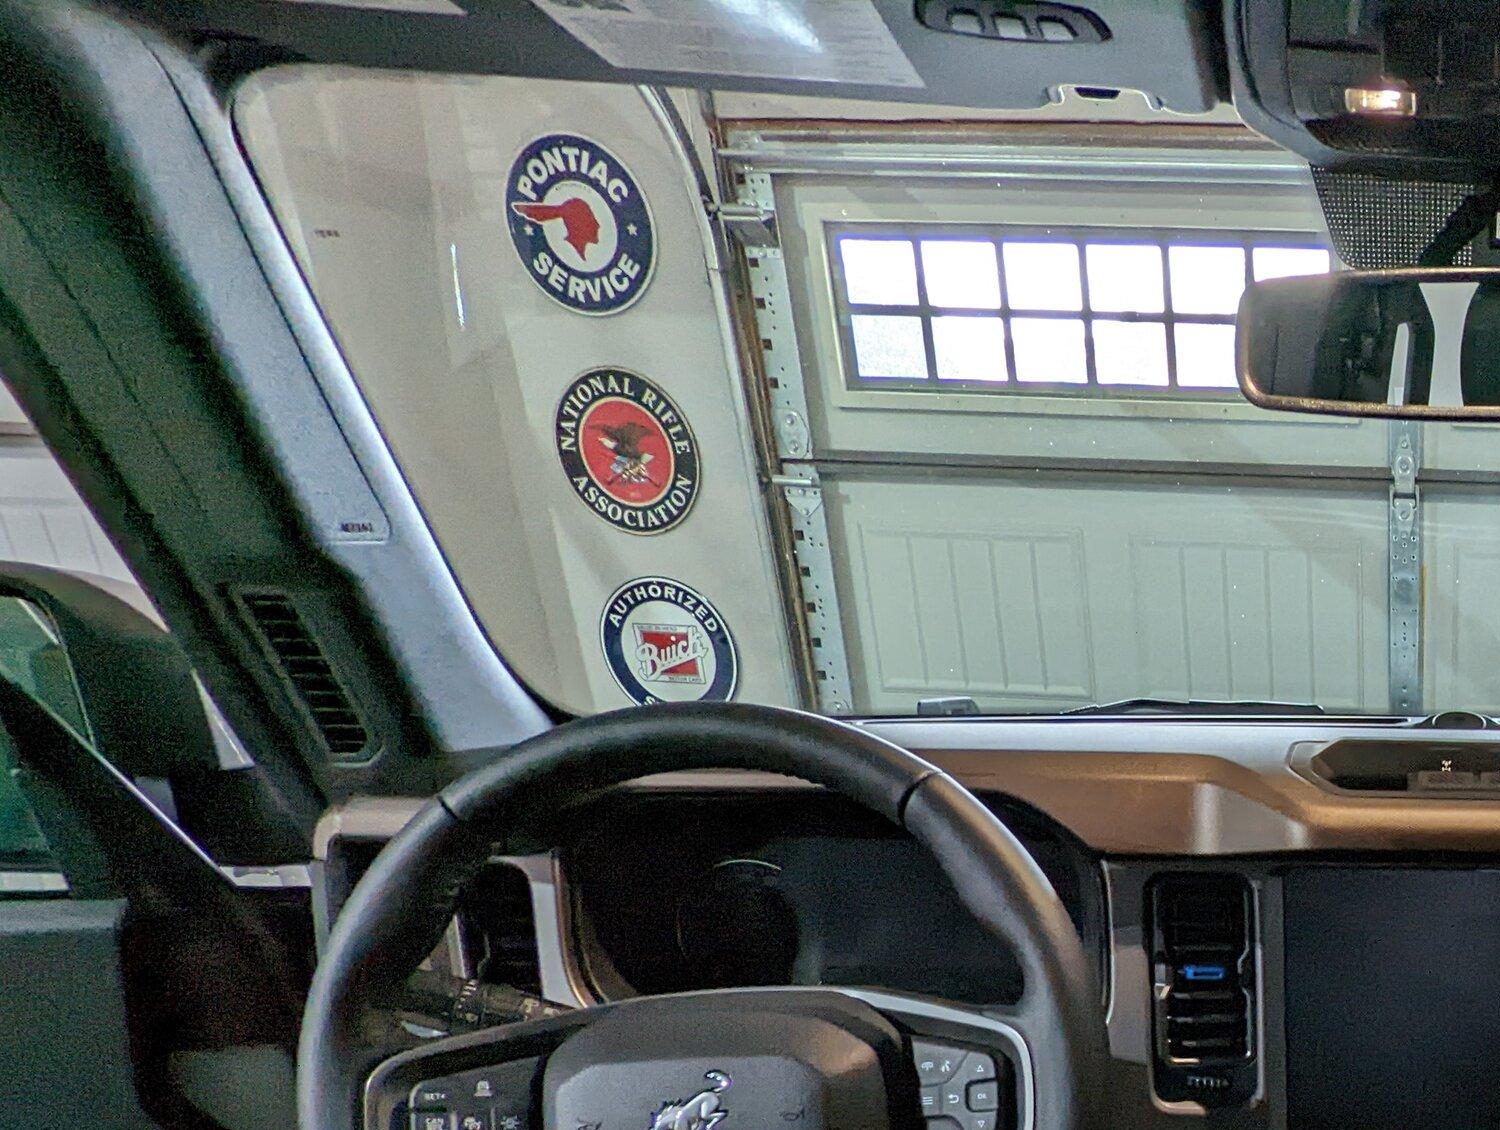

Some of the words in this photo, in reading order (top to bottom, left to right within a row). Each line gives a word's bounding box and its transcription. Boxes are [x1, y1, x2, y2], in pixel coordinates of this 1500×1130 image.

[517, 146, 629, 203] PONTIAC
[533, 251, 640, 304] SERVICE
[560, 374, 635, 452] NATIONAL
[640, 387, 691, 455] RIFLE
[572, 473, 693, 528] ASSOCIATION
[608, 584, 718, 628] AUTHORIZED
[635, 625, 708, 682] Buick
